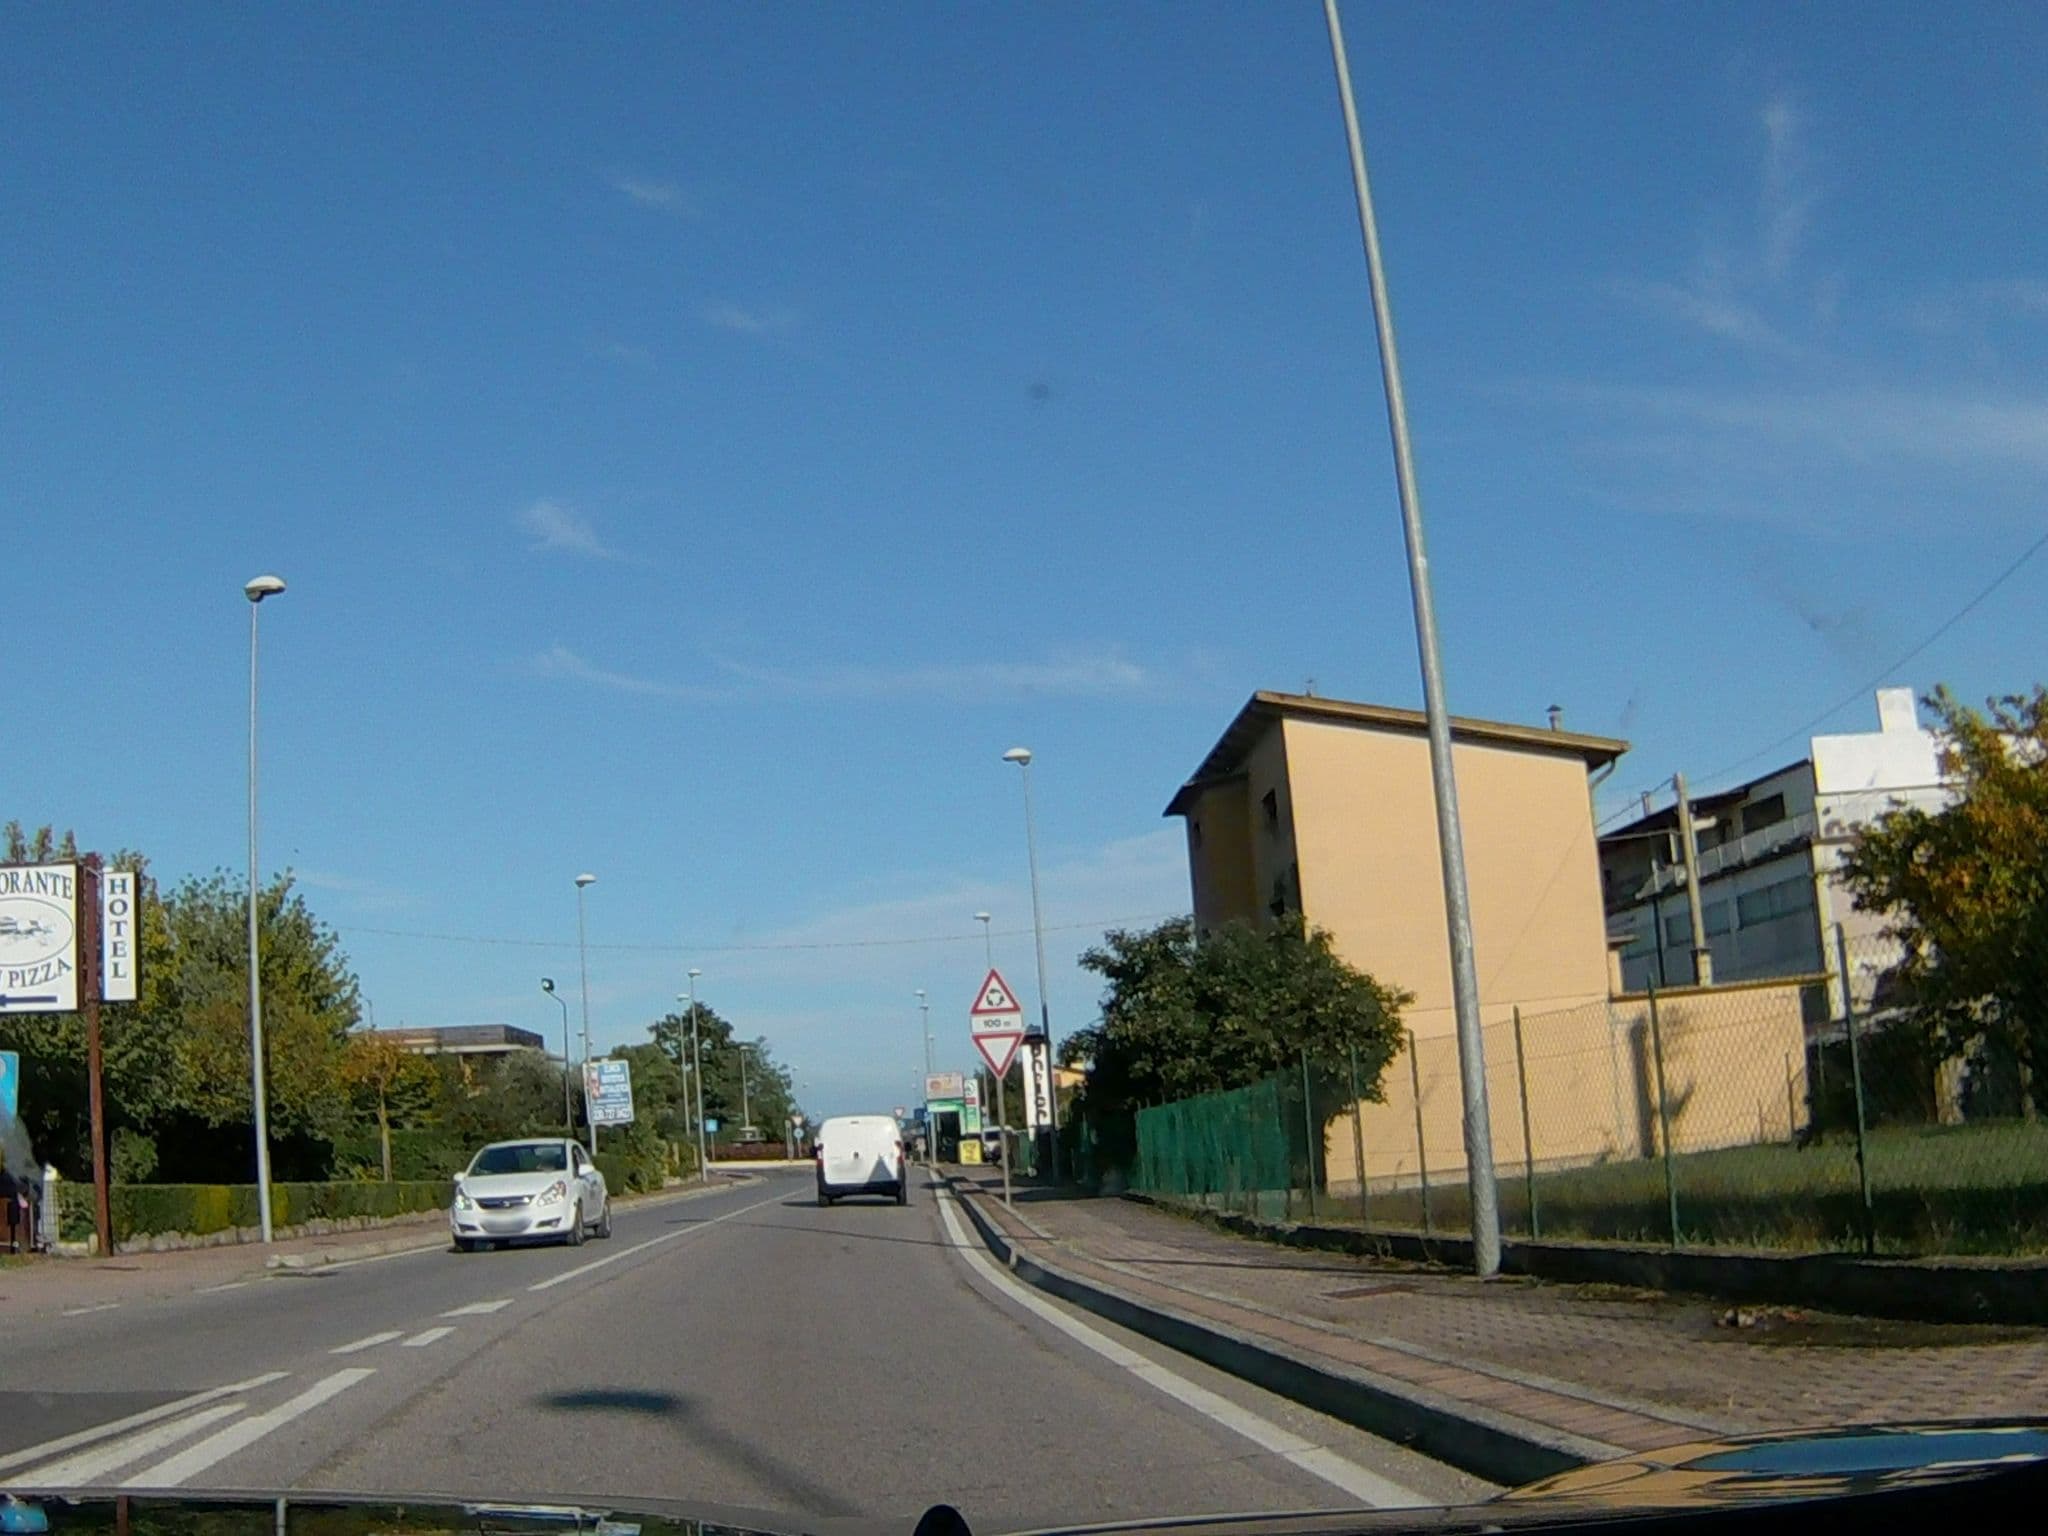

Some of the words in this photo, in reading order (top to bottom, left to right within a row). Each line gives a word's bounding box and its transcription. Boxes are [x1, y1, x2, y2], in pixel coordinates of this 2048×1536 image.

[109, 878, 128, 979] HOTEL
[8, 957, 72, 988] PIZZA
[983, 1019, 1002, 1028] 100
